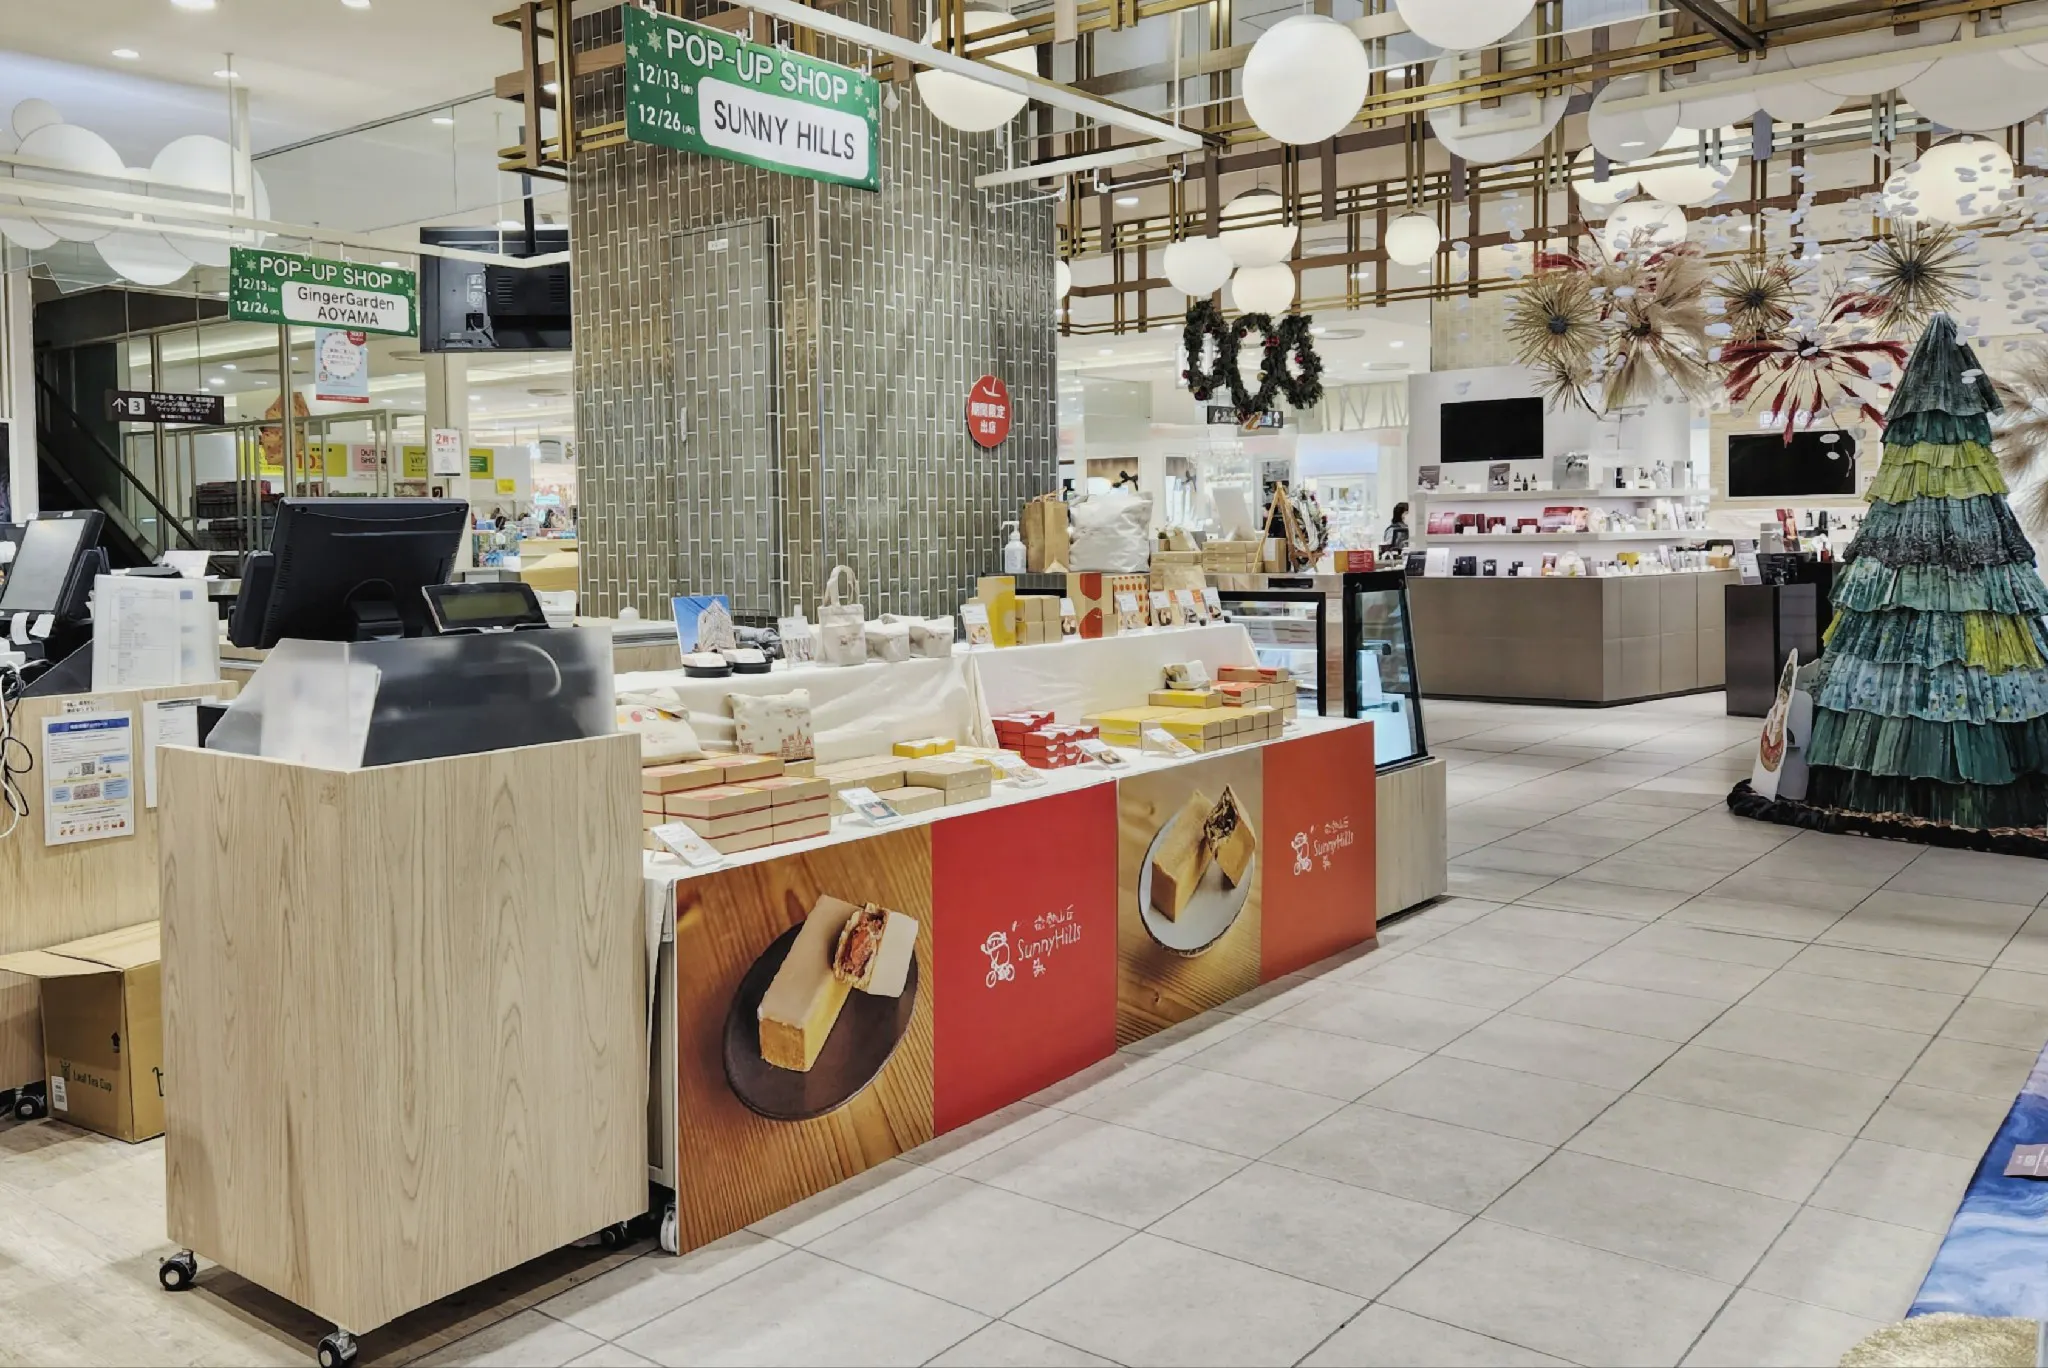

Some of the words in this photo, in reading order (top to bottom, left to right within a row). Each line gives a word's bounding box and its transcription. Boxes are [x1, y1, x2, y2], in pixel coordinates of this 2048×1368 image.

[666, 27, 774, 84] POP-UP
[779, 60, 848, 104] SHOP
[714, 99, 789, 145] SUNNY
[797, 122, 855, 160] HILLS
[260, 256, 337, 282] POP-UP
[343, 267, 393, 289] SHOP
[297, 286, 395, 311] GingerGarden
[317, 306, 379, 326] AOYAMA
[133, 400, 141, 412] 3
[1018, 923, 1081, 961] SunnyHills
[88, 1075, 98, 1088] Tea
